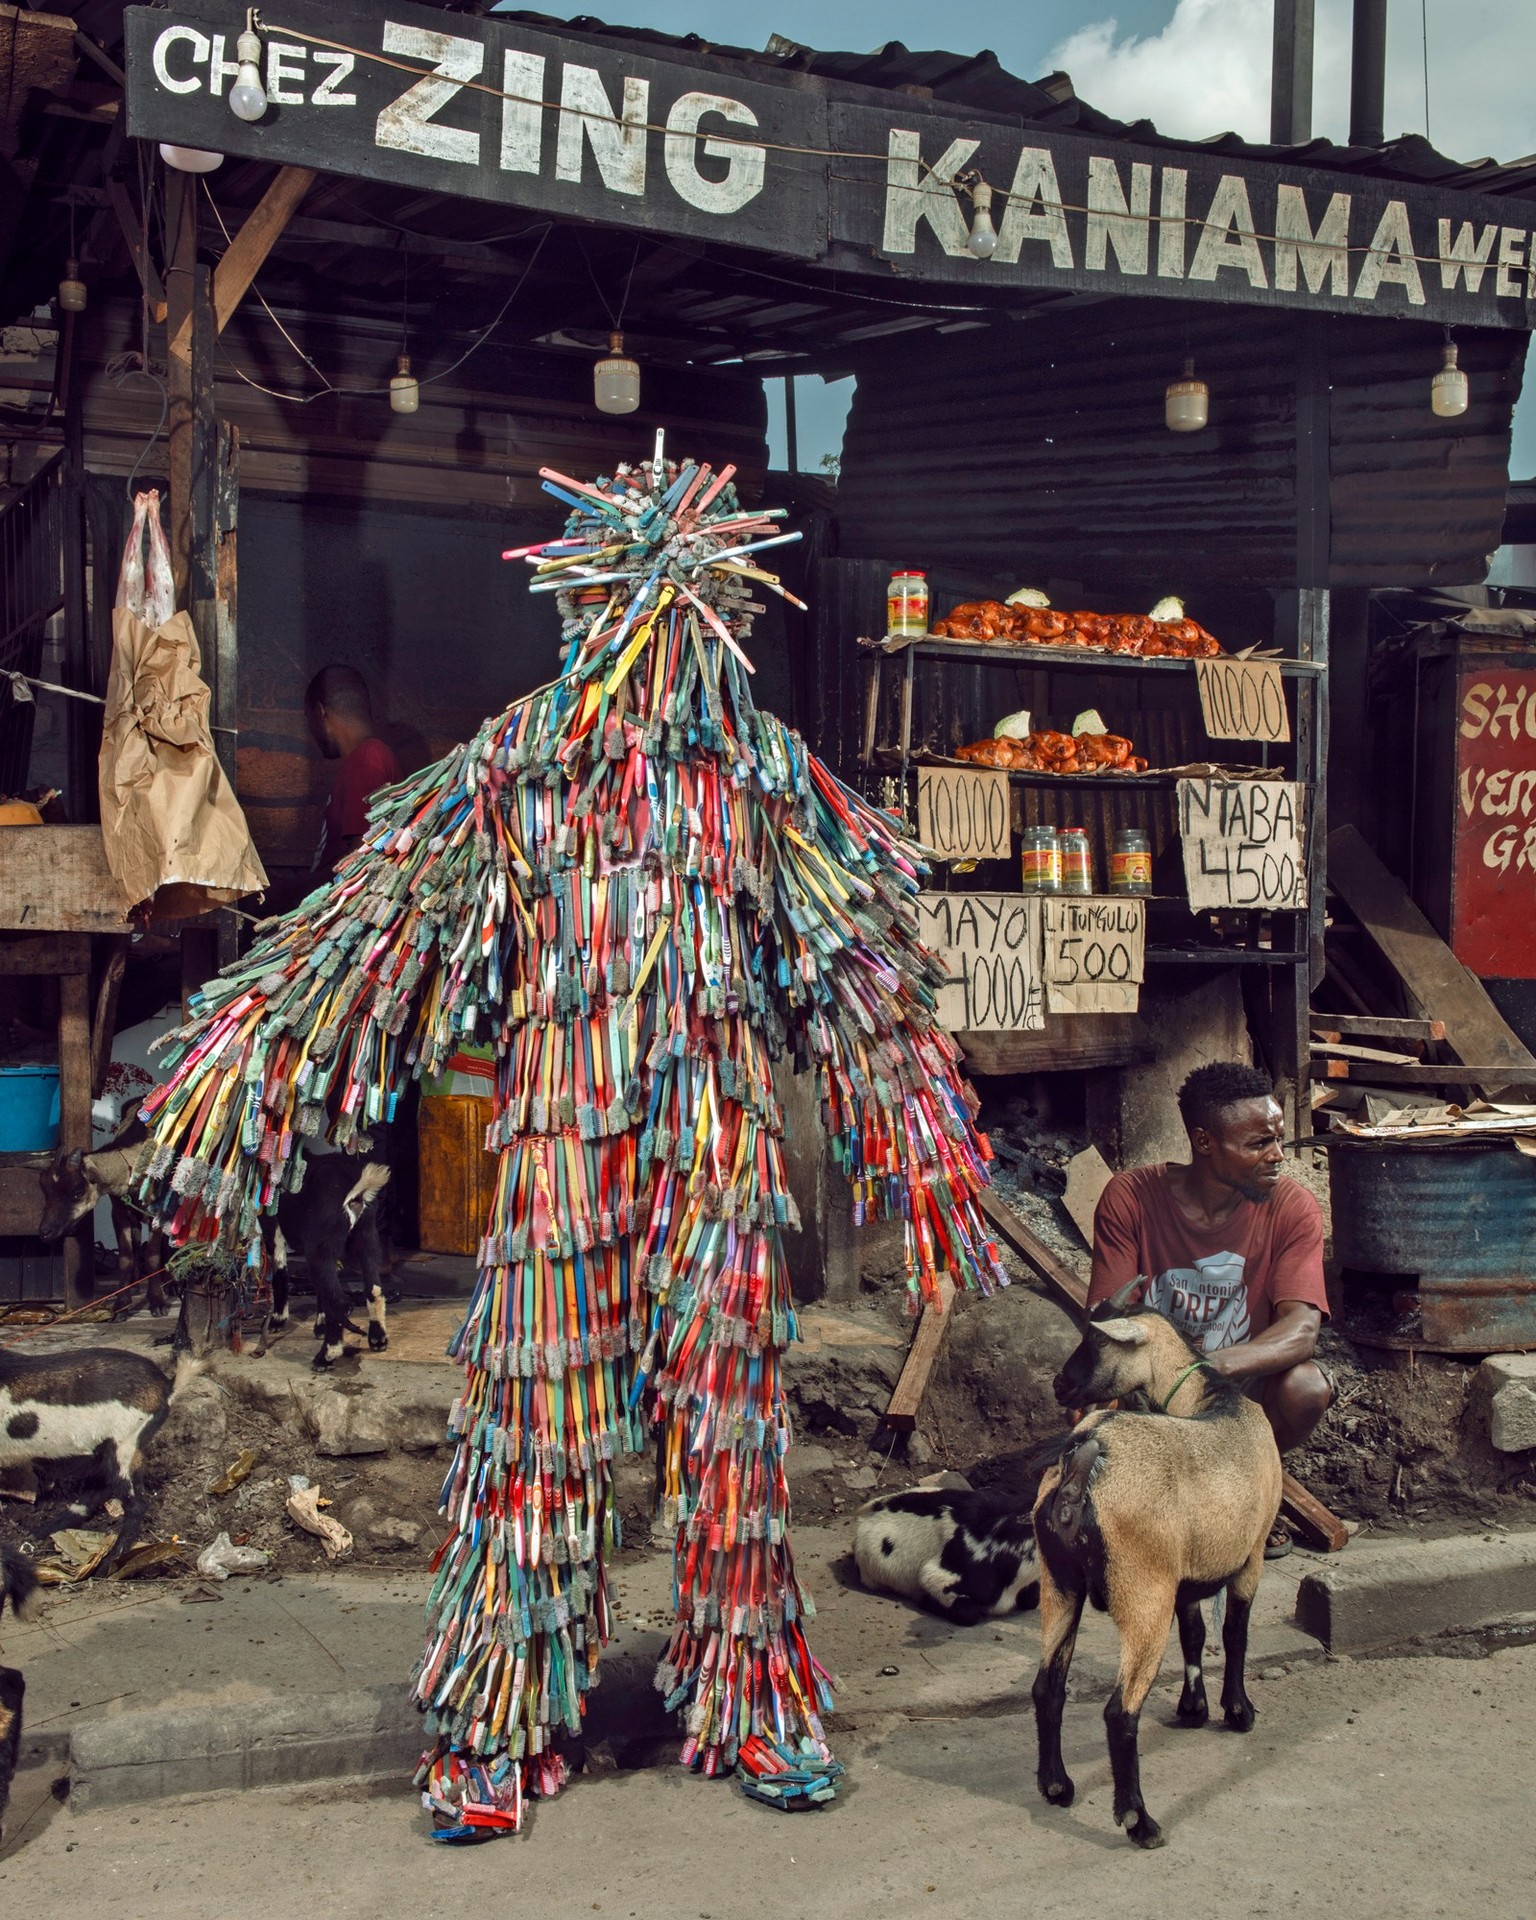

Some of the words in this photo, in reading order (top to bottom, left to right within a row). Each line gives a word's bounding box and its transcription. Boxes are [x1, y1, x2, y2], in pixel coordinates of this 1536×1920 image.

[153, 26, 357, 105] CHEZ
[376, 20, 766, 214] ZING
[882, 128, 1426, 304] KANIAMA
[1185, 779, 1294, 844] NTABA
[914, 896, 1028, 953] MAYO
[1053, 938, 1131, 986] 500
[1169, 1273, 1188, 1290] San
[1192, 1280, 1239, 1297] ntonio
